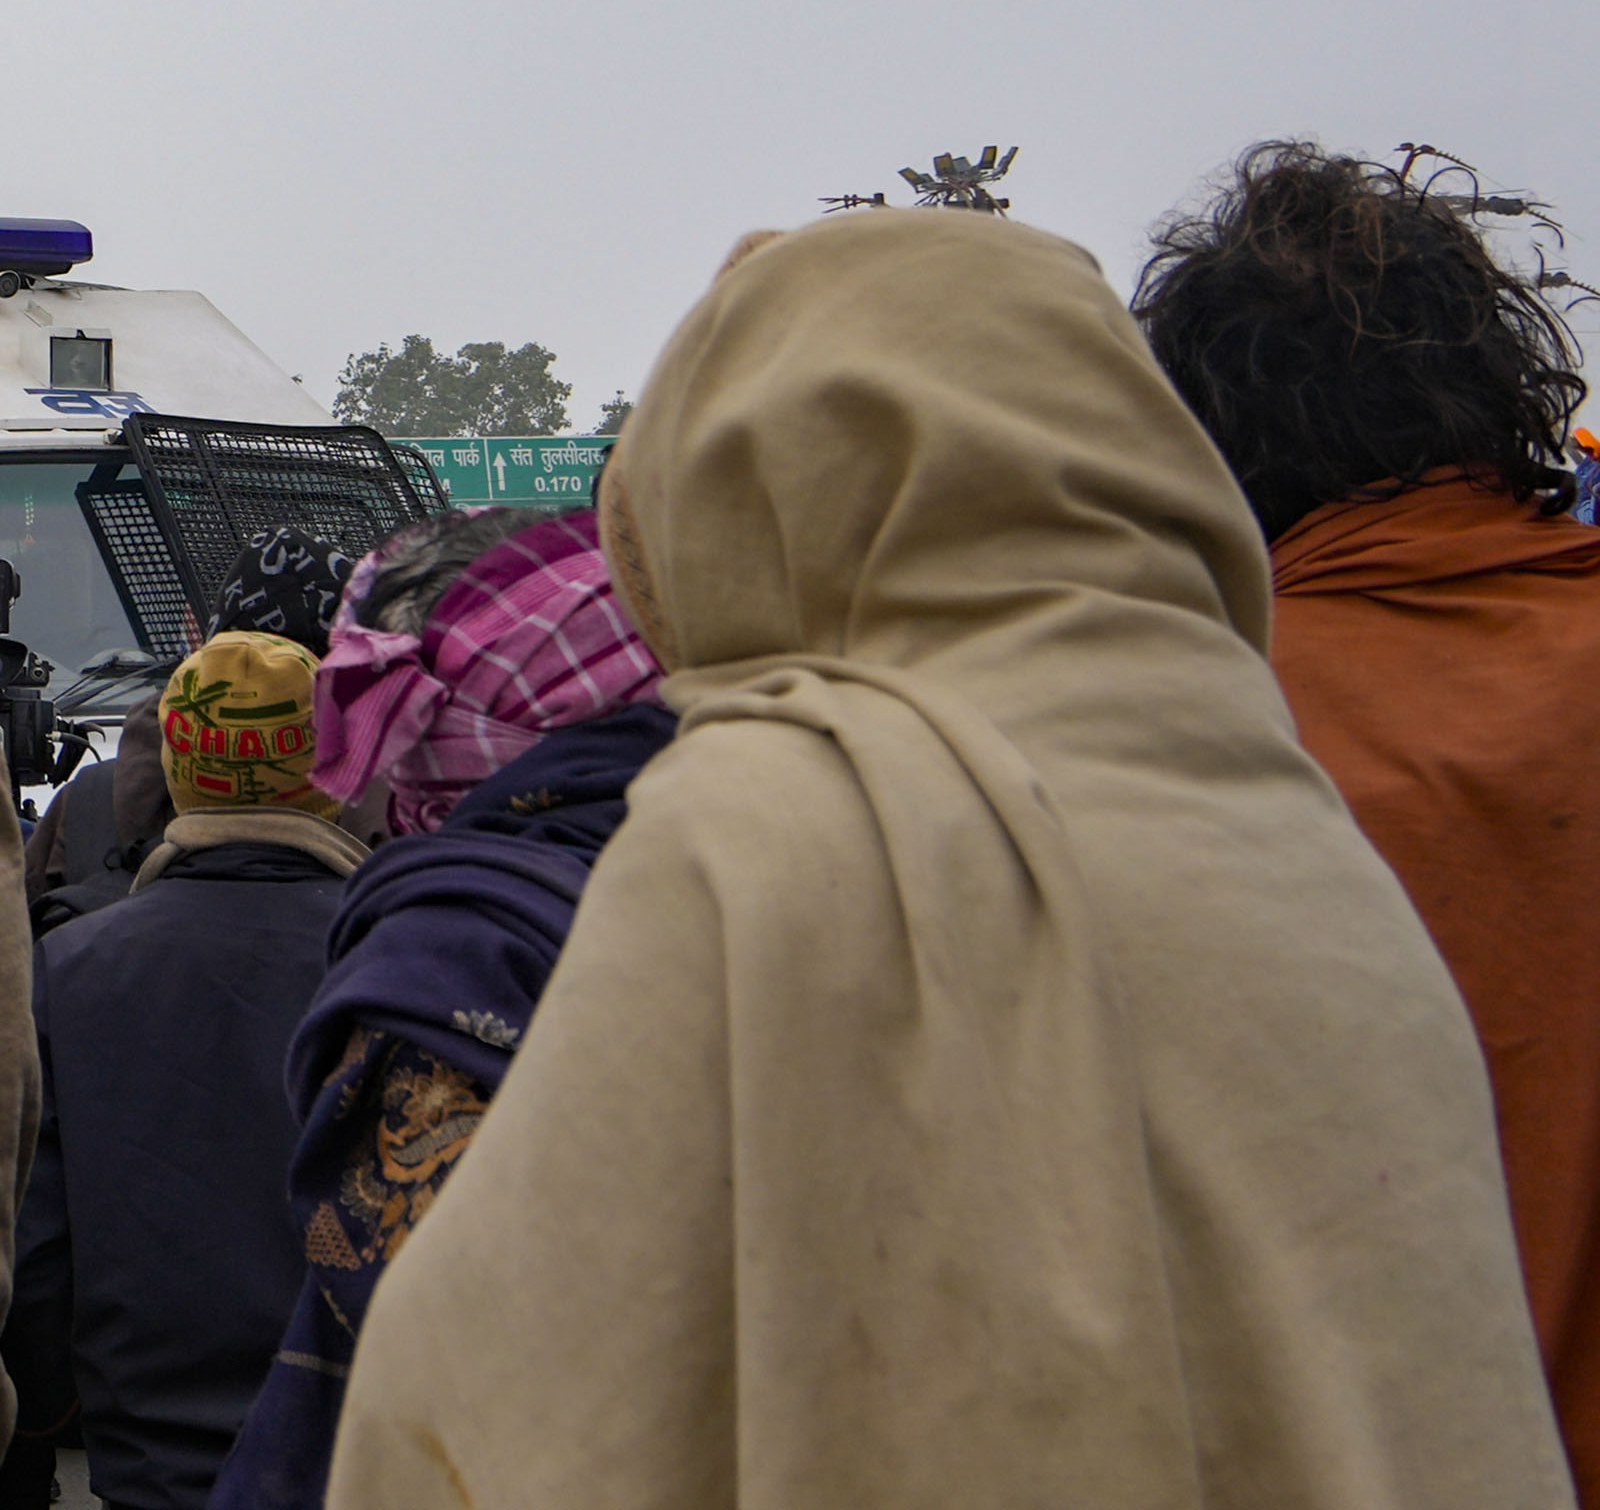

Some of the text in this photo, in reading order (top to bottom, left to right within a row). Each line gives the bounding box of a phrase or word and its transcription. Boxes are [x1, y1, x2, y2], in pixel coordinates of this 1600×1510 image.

[452, 441, 480, 467] पार्क
[509, 440, 605, 473] संत तुलसीदास
[534, 476, 582, 492] 0.170
[165, 709, 315, 759] CHAO
